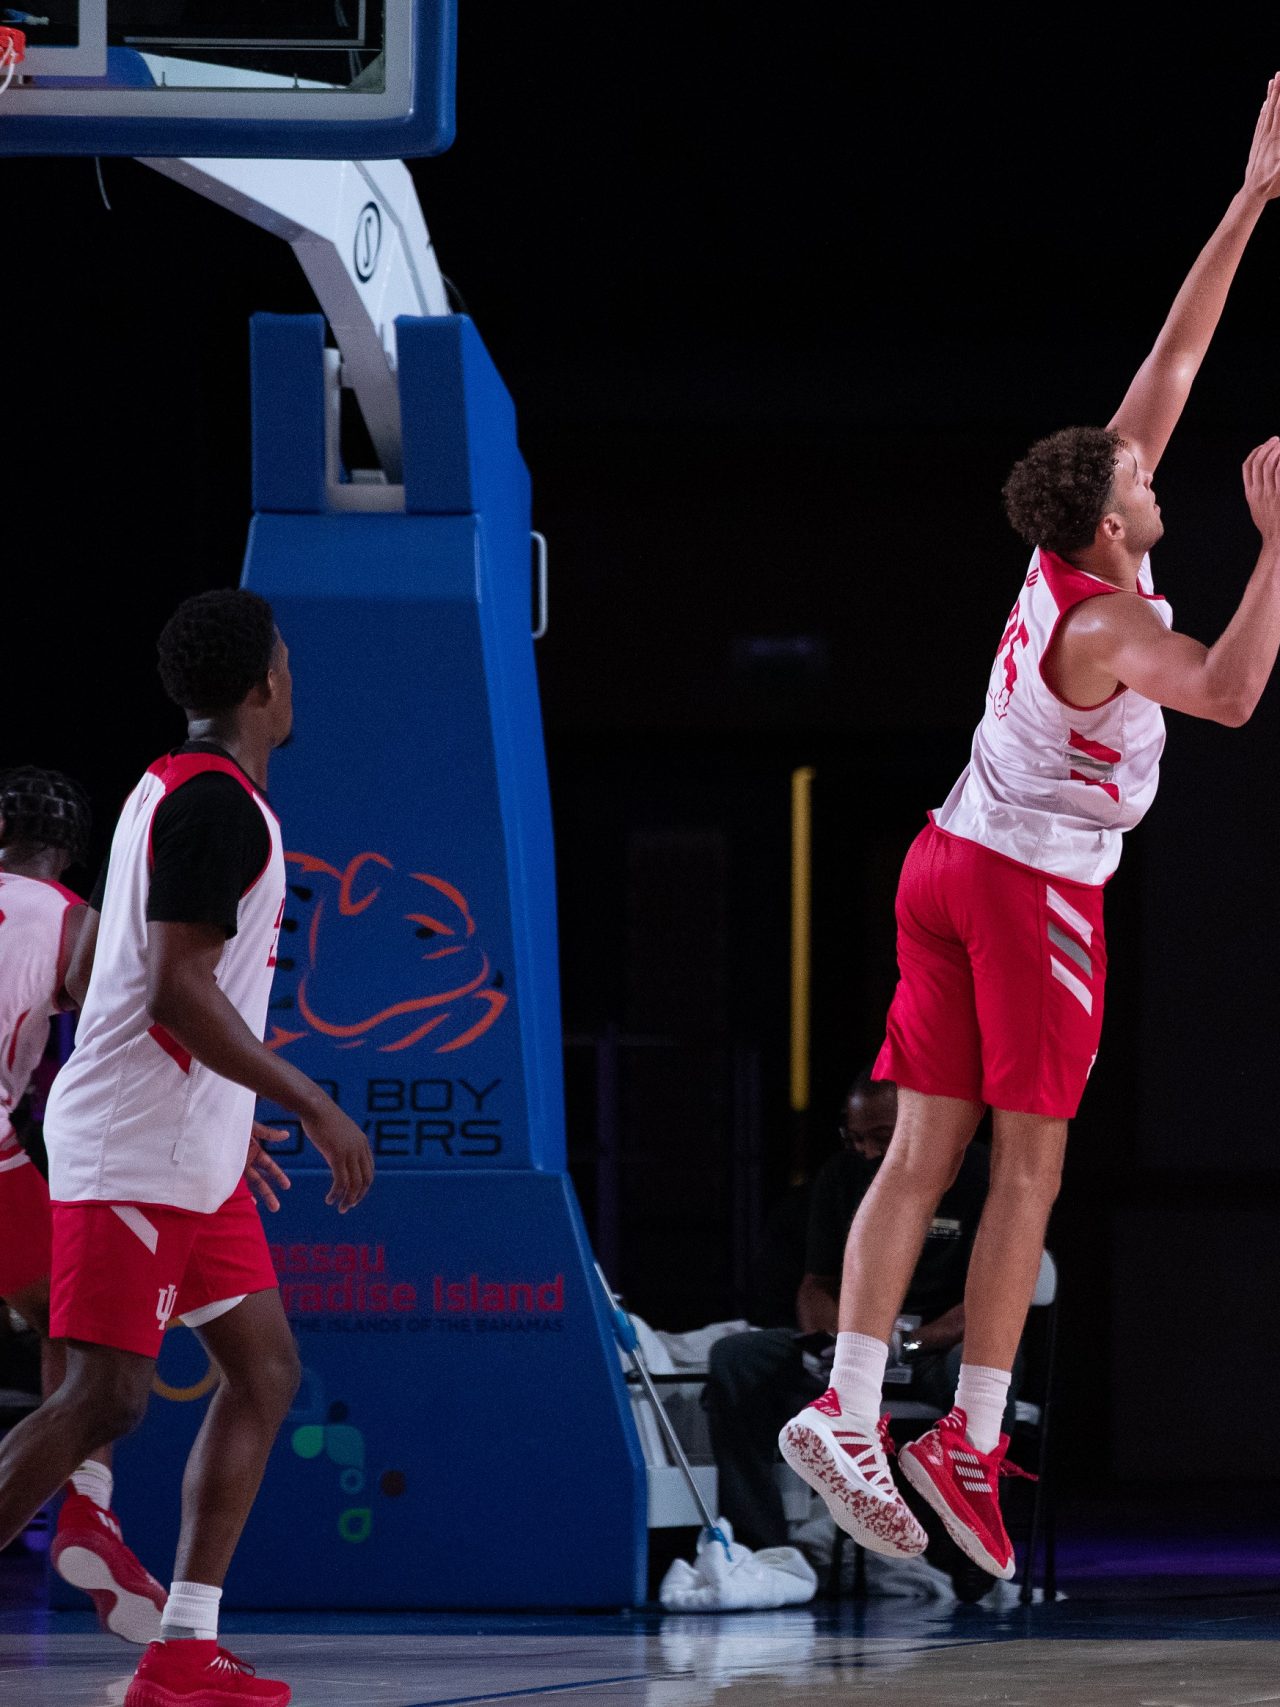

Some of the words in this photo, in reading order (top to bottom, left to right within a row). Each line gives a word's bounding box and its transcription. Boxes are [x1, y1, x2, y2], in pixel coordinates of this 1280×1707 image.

[367, 1078, 503, 1112] BOY
[262, 1119, 502, 1156] OERS
[271, 1243, 385, 1272] assau
[281, 1274, 417, 1313] radise
[433, 1273, 565, 1313] Island
[290, 1318, 321, 1334] THE
[327, 1318, 402, 1334] ISLANDS
[407, 1318, 432, 1334] OF
[436, 1318, 472, 1334] THE
[476, 1318, 563, 1334] BAHAMAS
